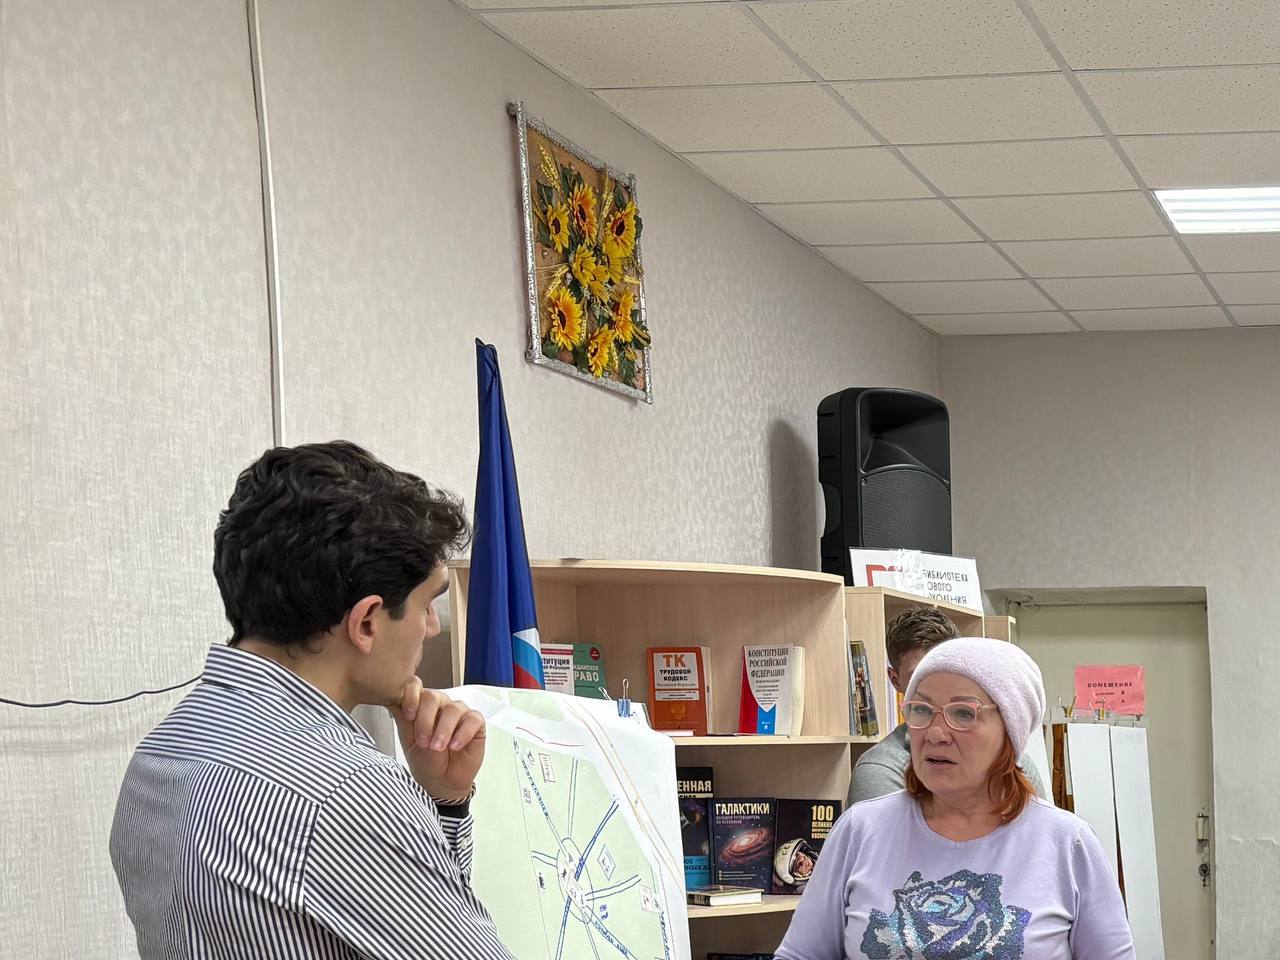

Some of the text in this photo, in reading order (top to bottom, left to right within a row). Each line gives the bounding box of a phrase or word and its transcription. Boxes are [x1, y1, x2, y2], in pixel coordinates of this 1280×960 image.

[927, 581, 952, 592] ОВОГО
[748, 648, 789, 657] КОНСТИТУЦИЯ
[663, 655, 686, 667] ТК
[749, 657, 787, 667] РОССИЙСКОЙ
[751, 669, 785, 677] ФЕДЕРАЦИИ
[715, 803, 770, 815] ГАЛАКТИКИ
[811, 805, 834, 821] 100
